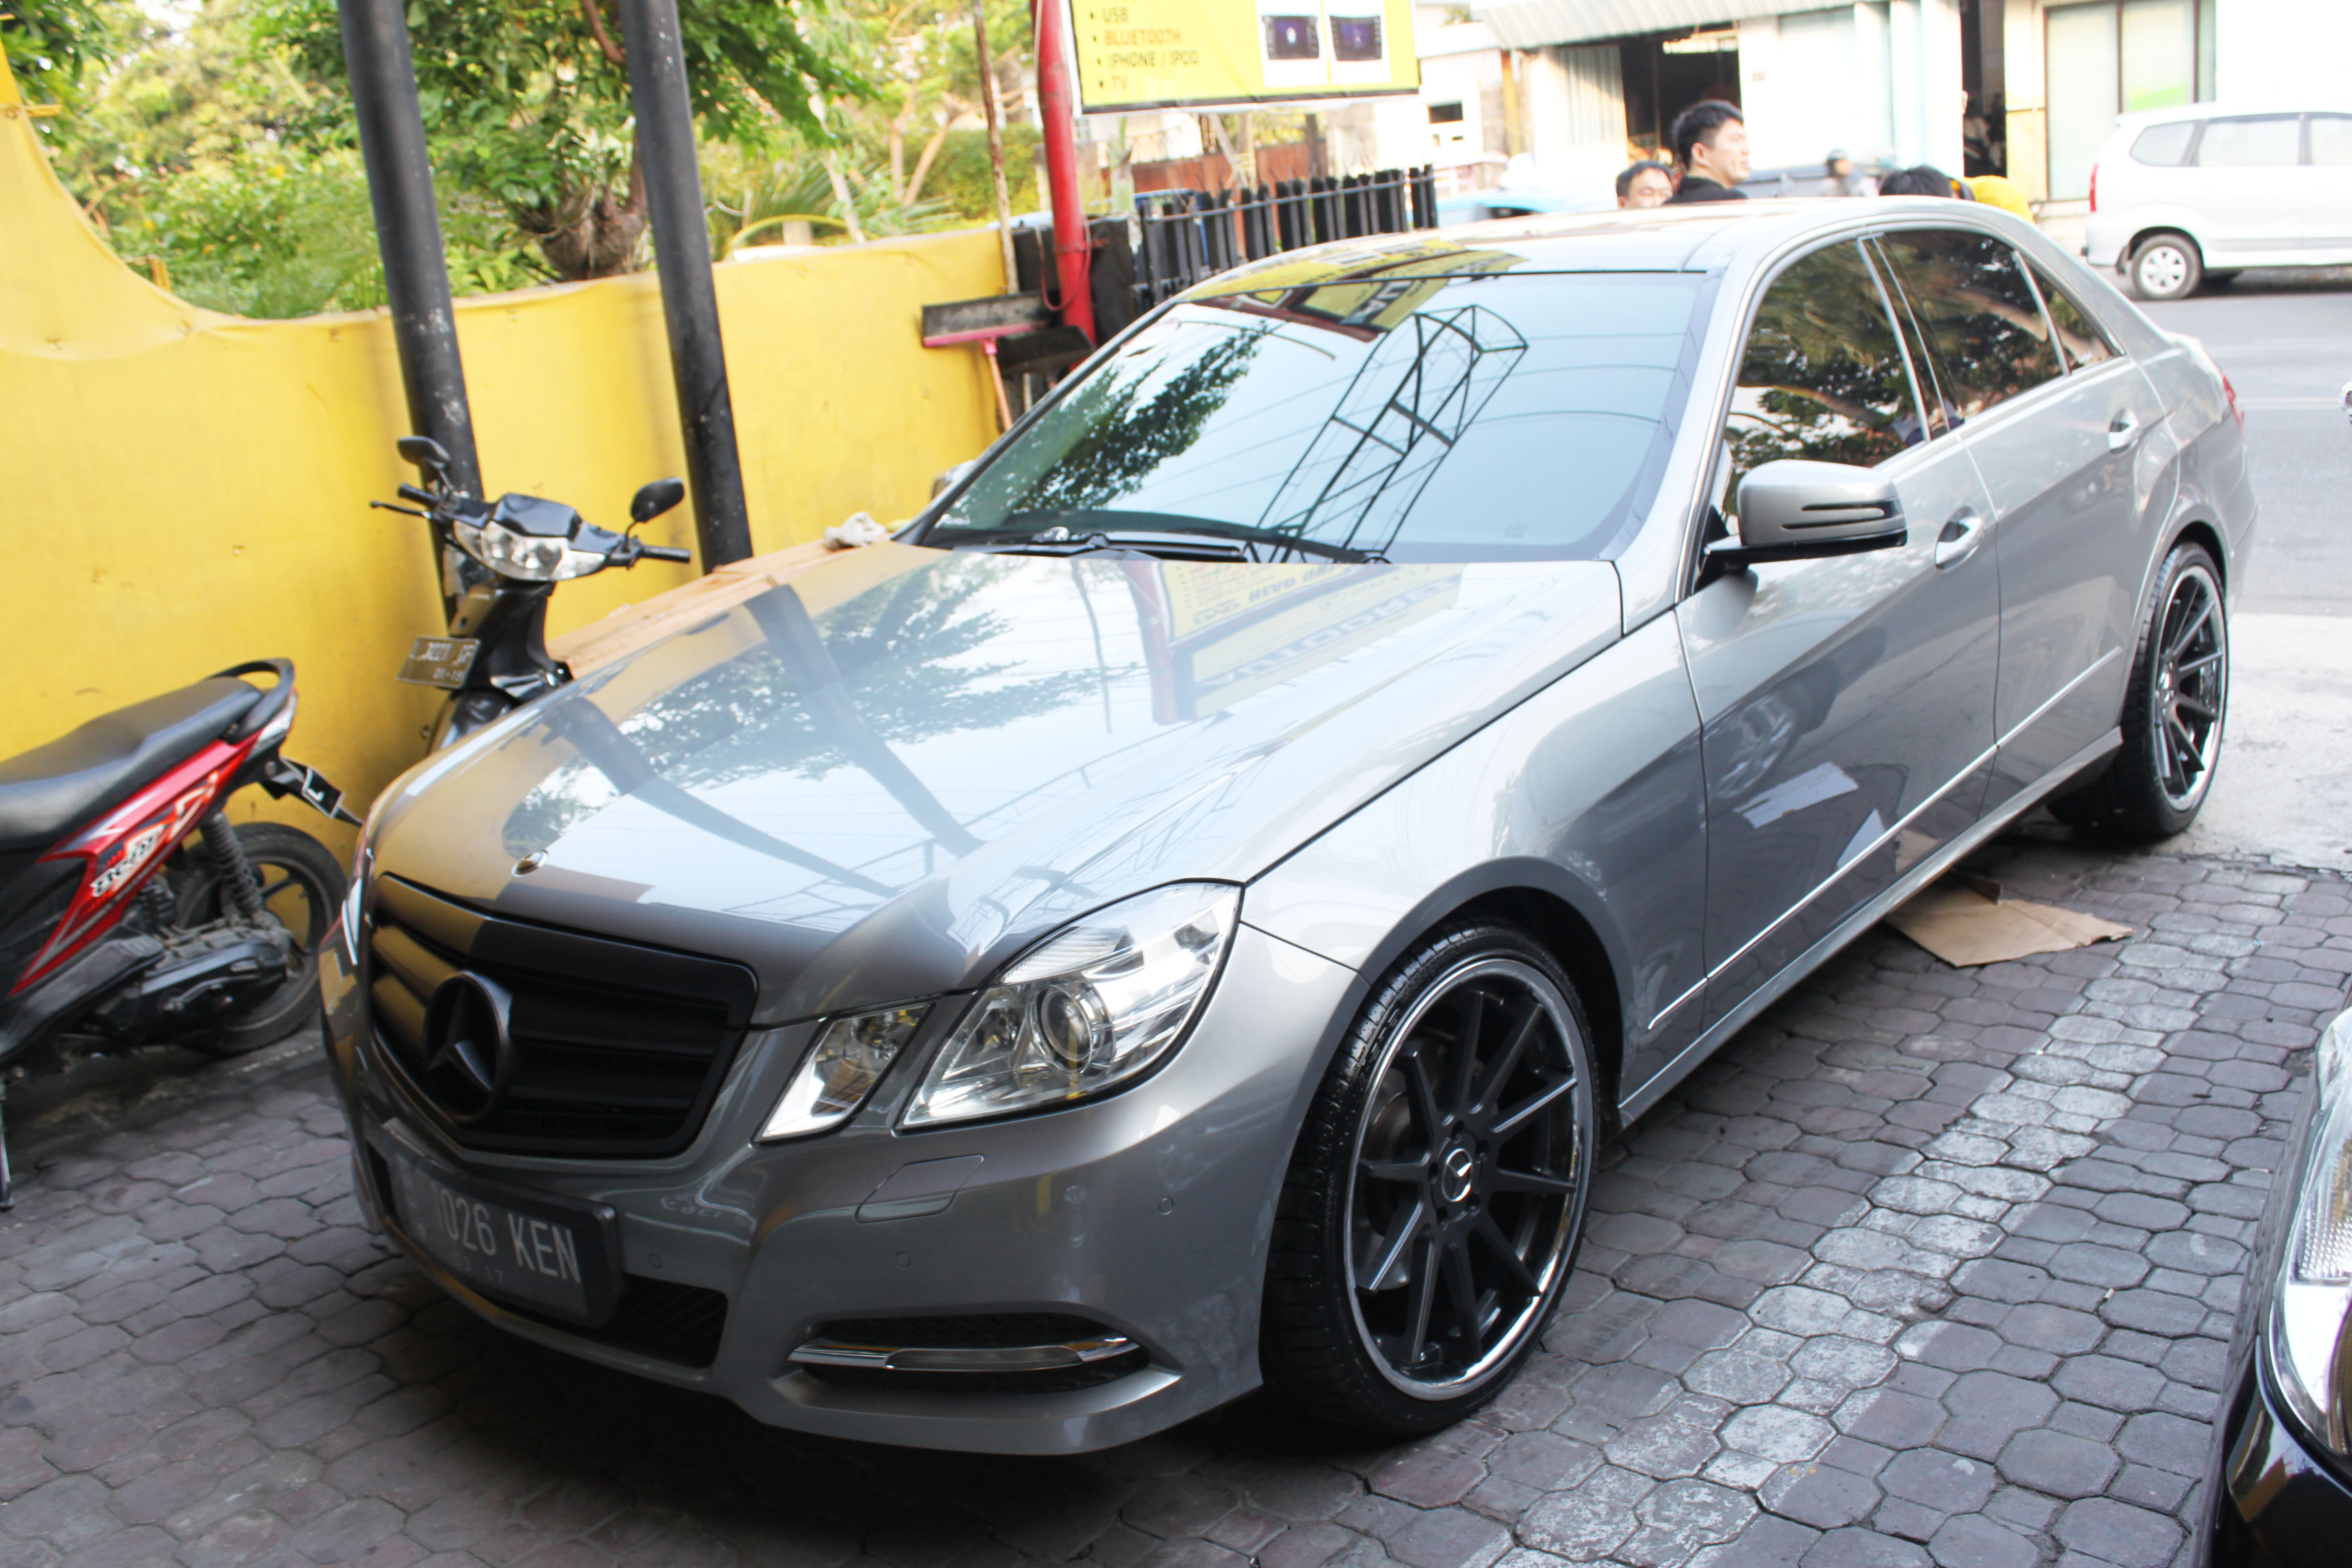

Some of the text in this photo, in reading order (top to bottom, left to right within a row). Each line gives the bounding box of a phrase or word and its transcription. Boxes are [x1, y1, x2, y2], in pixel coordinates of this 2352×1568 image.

[1102, 7, 1128, 23] USB
[1105, 28, 1181, 46] BLUETOOTH
[1111, 75, 1127, 90] TV
[507, 1213, 581, 1284] KEN
